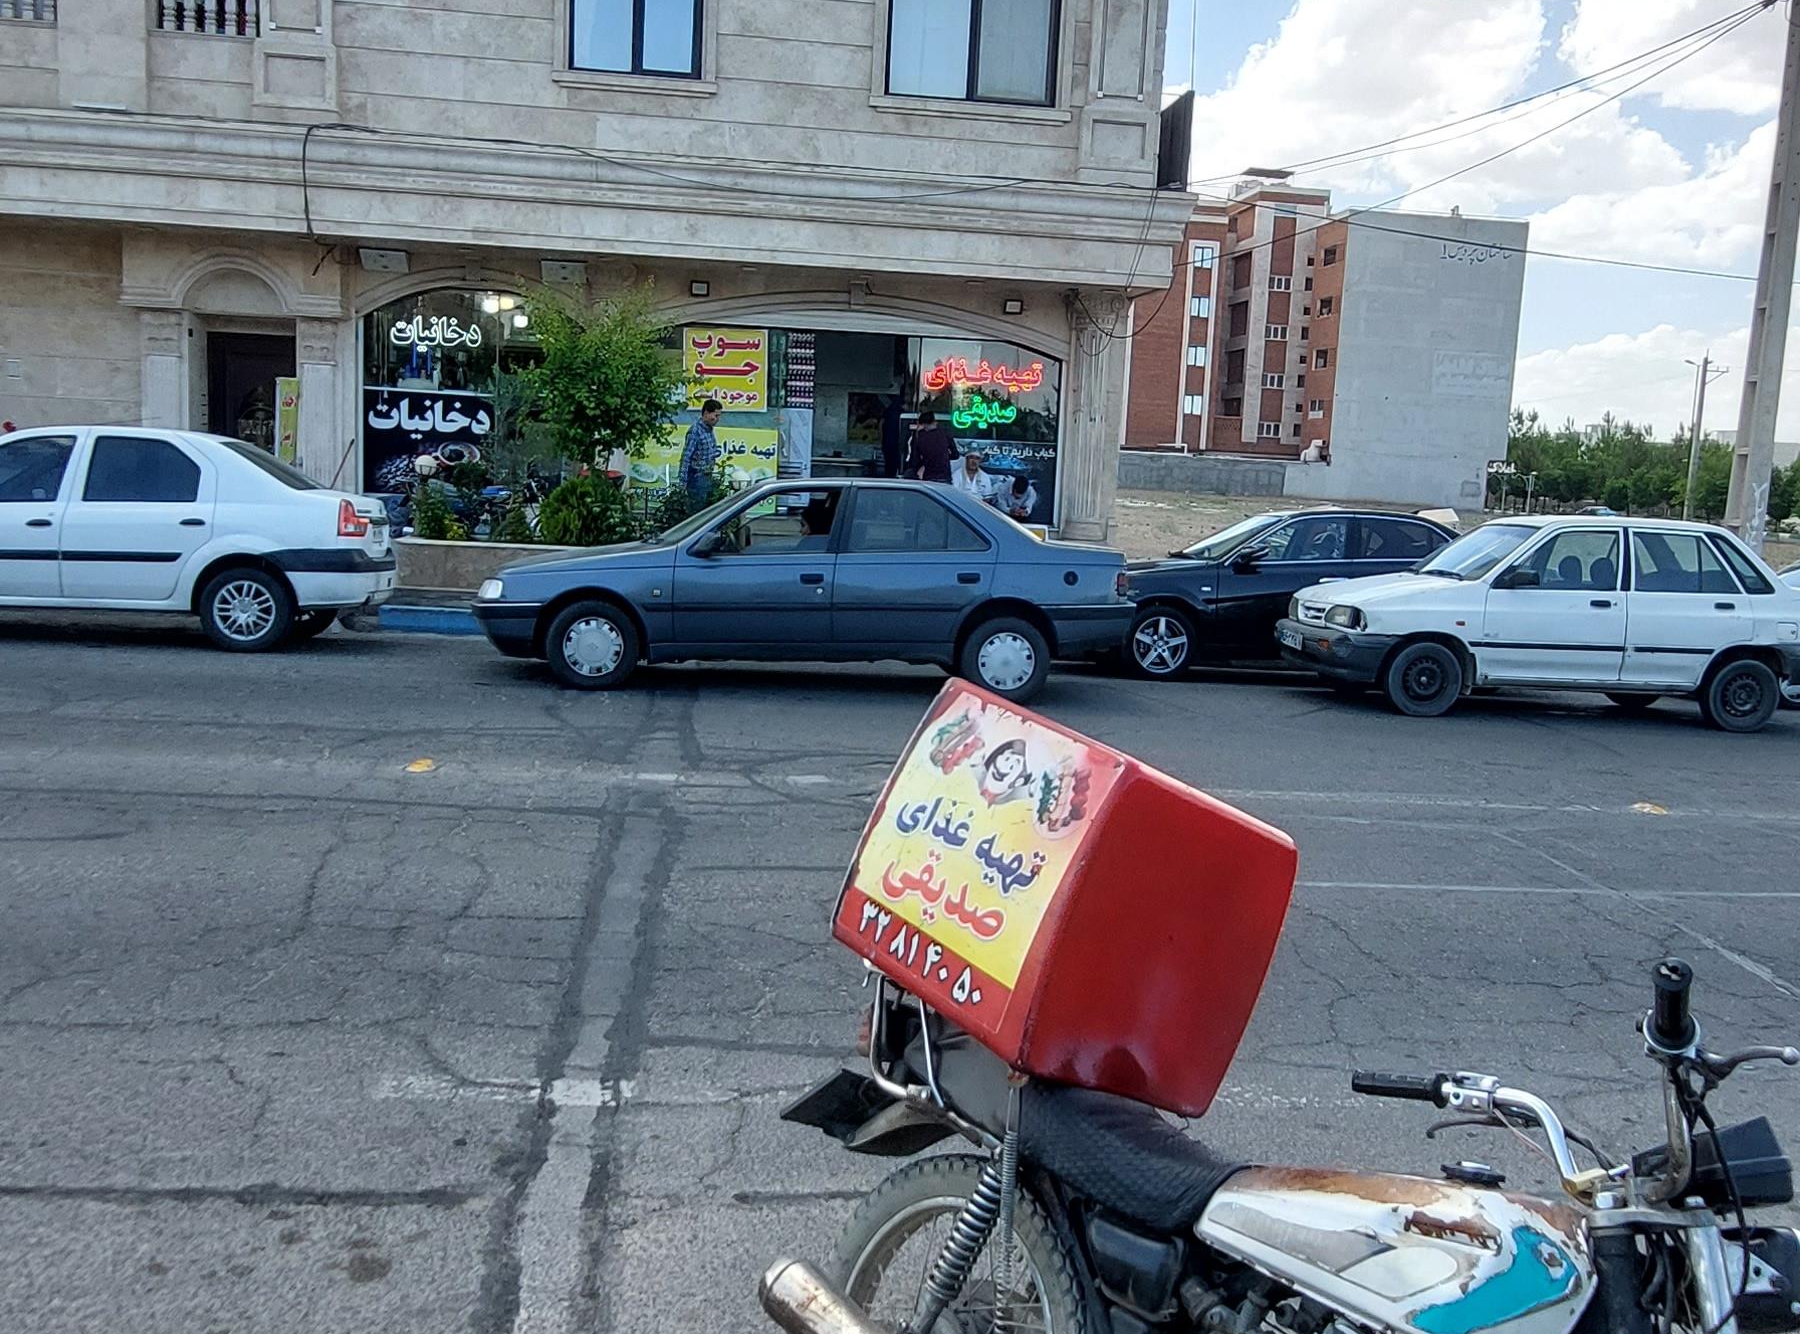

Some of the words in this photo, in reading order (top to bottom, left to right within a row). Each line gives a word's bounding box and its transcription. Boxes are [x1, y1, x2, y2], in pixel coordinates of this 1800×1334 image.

[390, 315, 482, 352] دخانیات
[691, 333, 761, 358] سوپ
[695, 361, 760, 384] جو
[924, 358, 992, 390] غذای
[993, 363, 1043, 392] تهیه
[721, 390, 758, 404] موجود
[952, 395, 1018, 429] صدیقی
[368, 398, 491, 440] دخانیات
[750, 443, 776, 459] تهیه
[1034, 447, 1056, 460] کباب
[895, 795, 974, 847] غذای
[975, 833, 1046, 895] تهیه
[881, 848, 1006, 939] صدیقی
